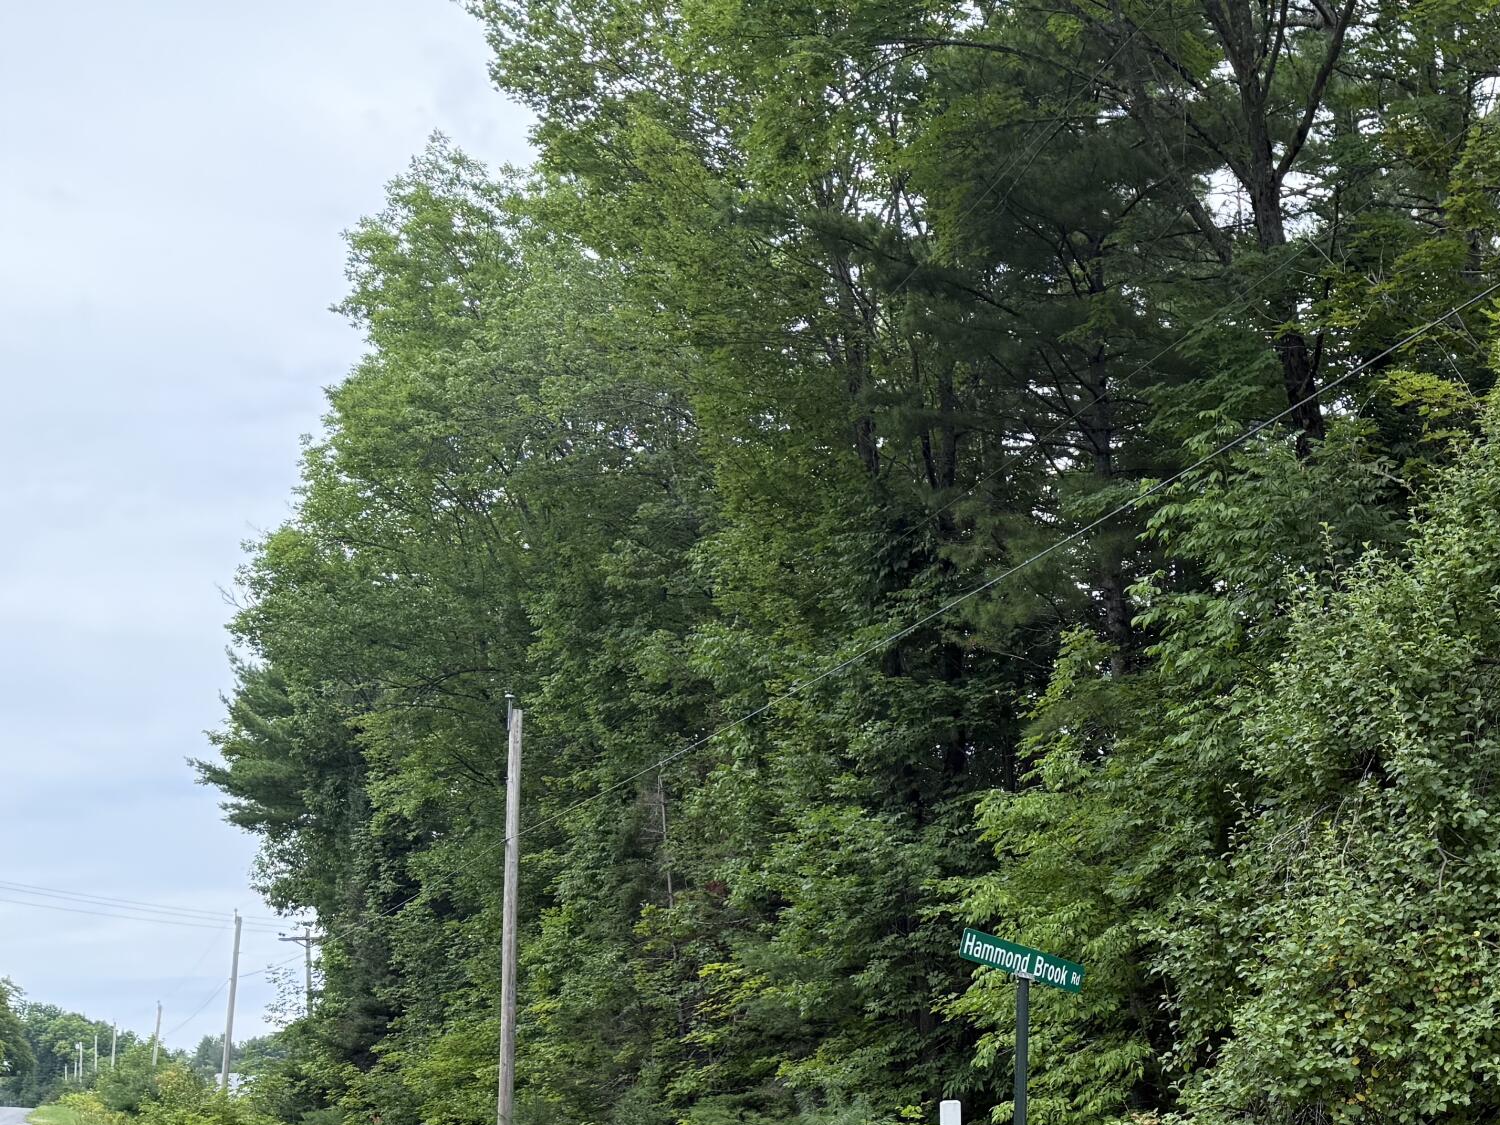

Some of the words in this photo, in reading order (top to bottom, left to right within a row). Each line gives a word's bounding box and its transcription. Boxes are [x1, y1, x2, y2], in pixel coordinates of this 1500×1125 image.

[963, 932, 1031, 973] Hammond
[1033, 955, 1069, 986] Brook
[1070, 971, 1082, 986] Rd
